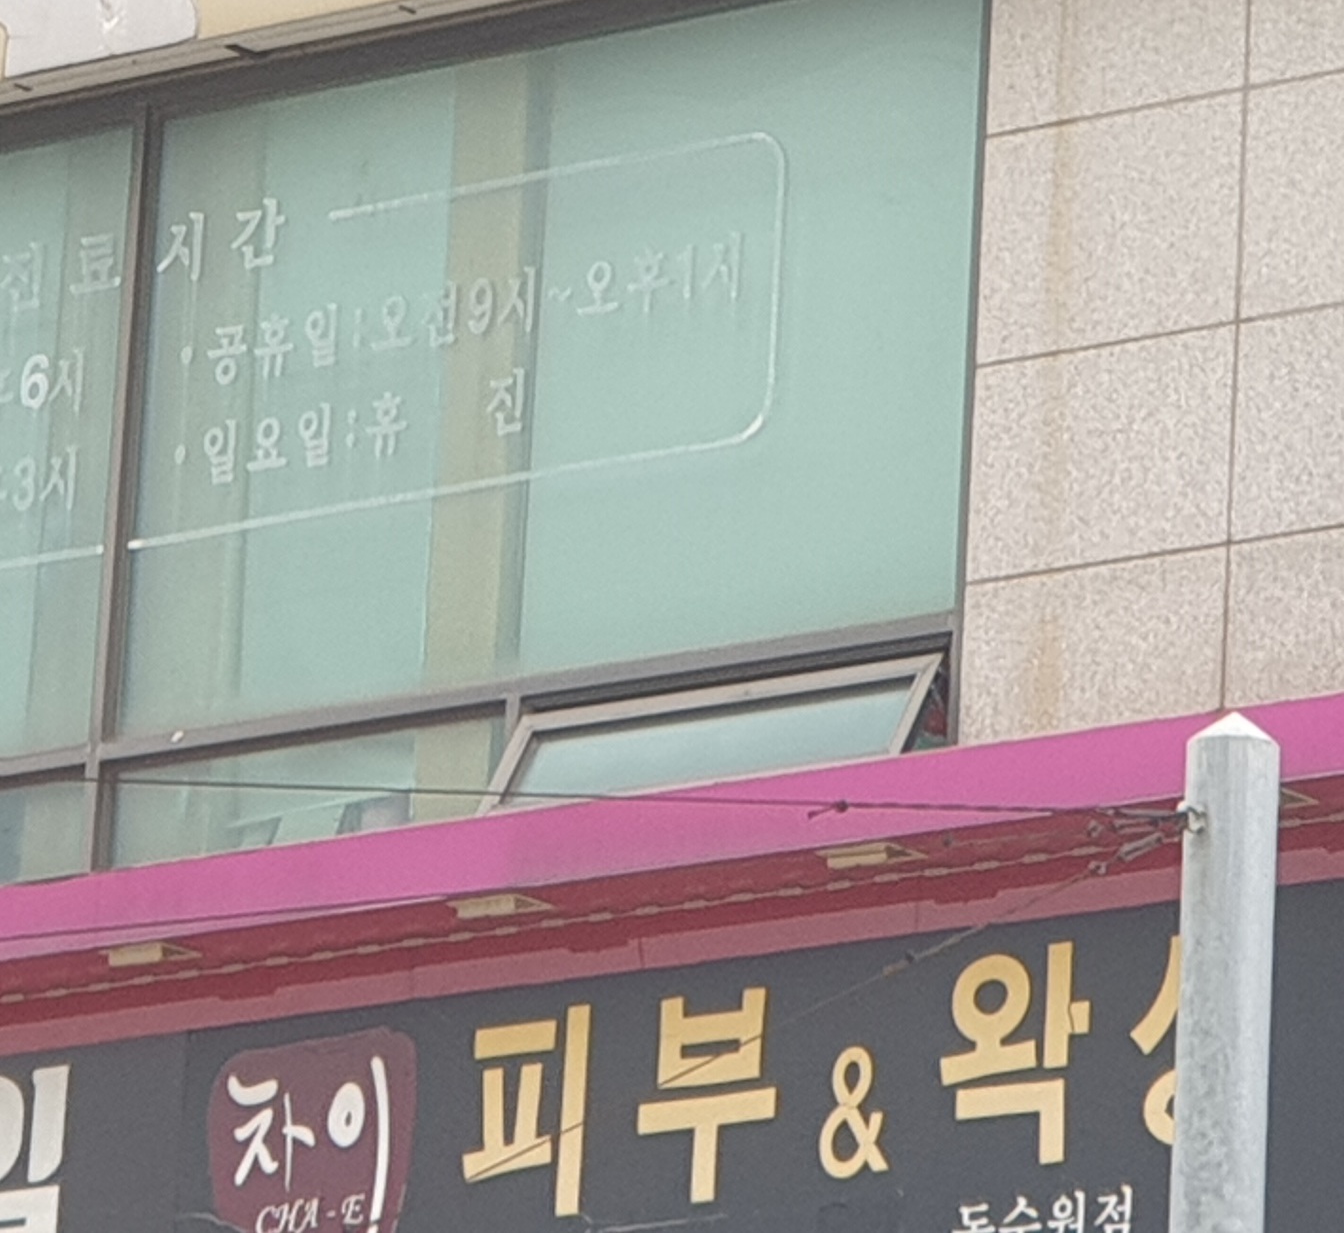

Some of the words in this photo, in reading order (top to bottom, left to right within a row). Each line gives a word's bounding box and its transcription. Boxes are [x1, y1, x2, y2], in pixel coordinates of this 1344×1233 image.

[227, 1055, 390, 1233] 차이
[462, 987, 777, 1218] 피부
[819, 1045, 889, 1180] &
